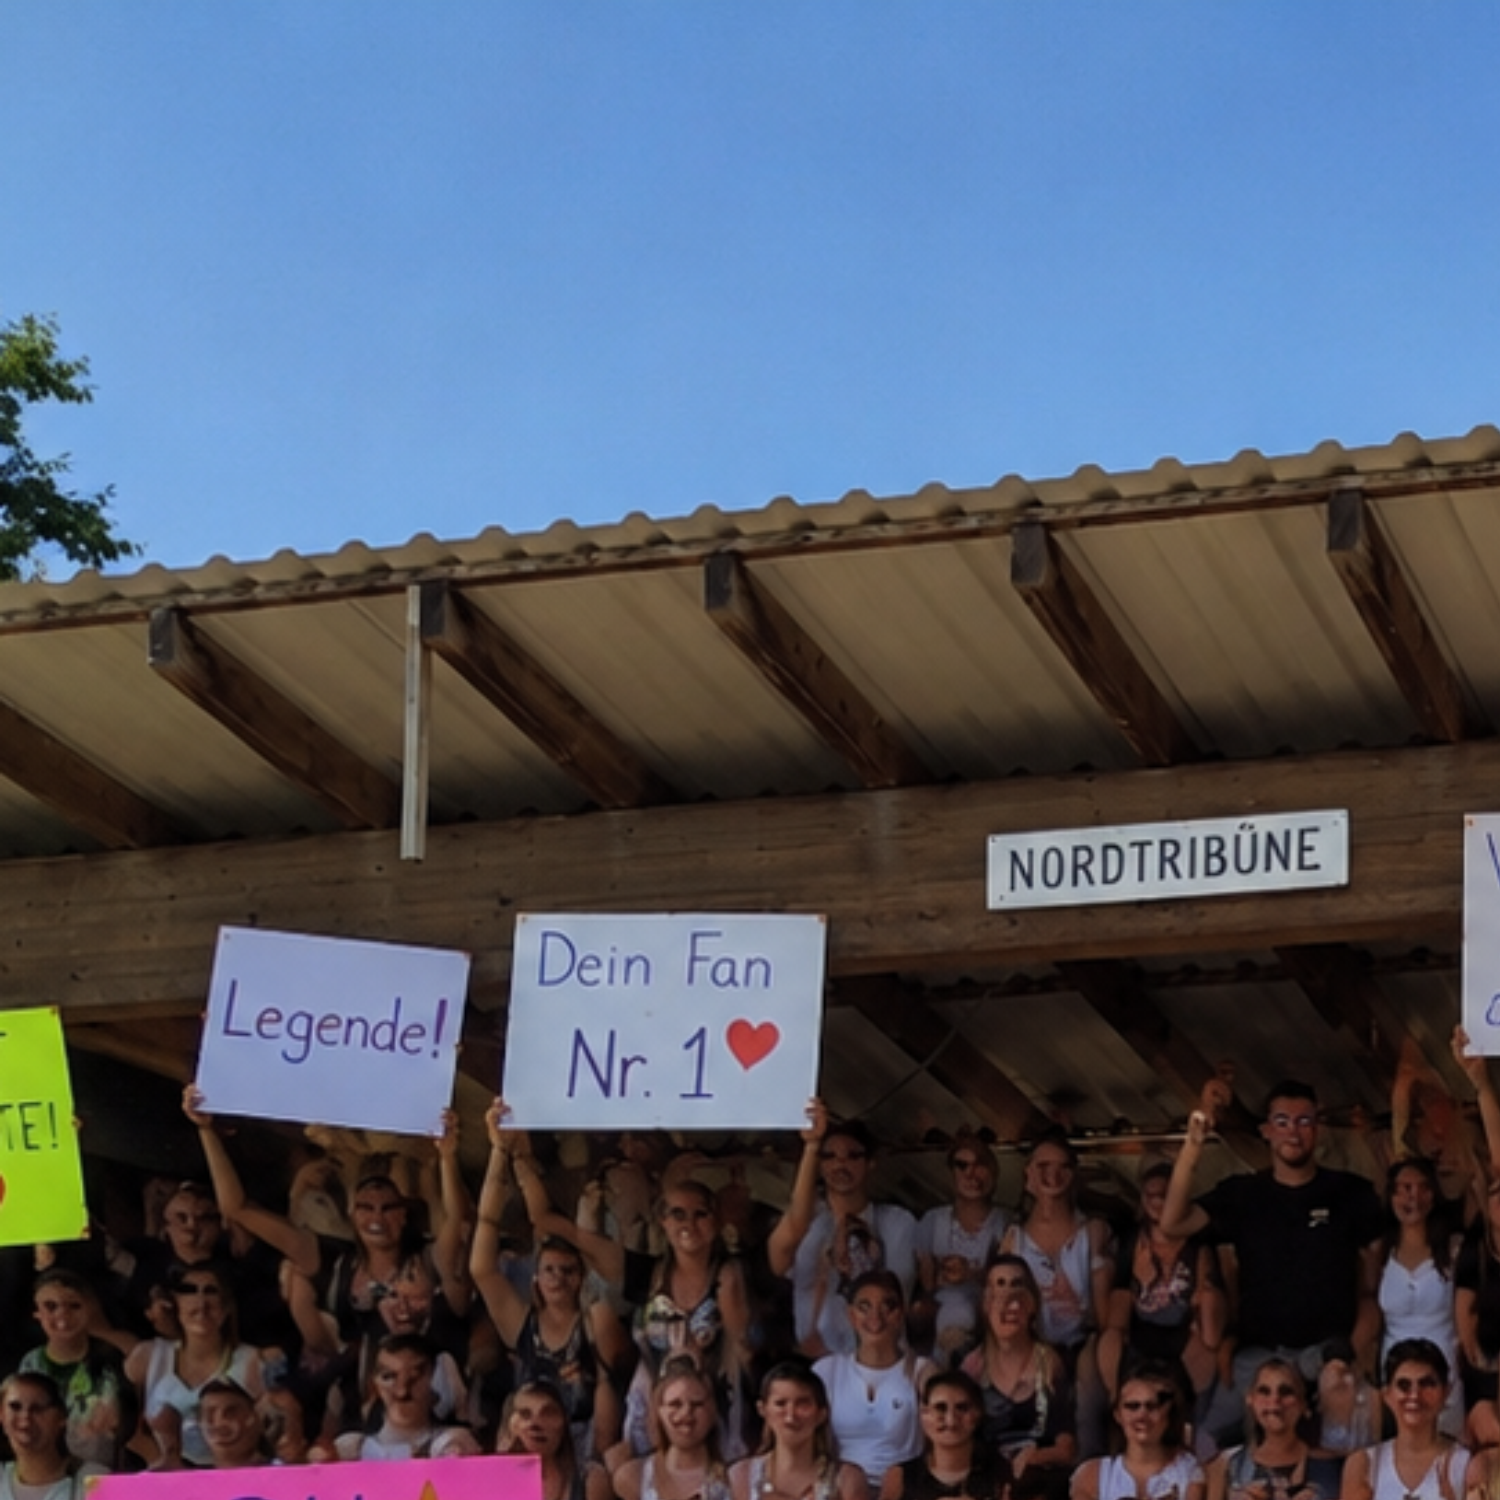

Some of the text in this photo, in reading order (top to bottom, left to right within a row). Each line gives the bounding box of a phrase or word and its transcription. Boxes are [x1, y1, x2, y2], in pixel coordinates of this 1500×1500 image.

[1008, 823, 1322, 892] NORDTRIBÜNE
[538, 930, 772, 988] Dein Fan
[222, 979, 450, 1064] Legende!
[567, 1027, 714, 1099] Nr. 1
